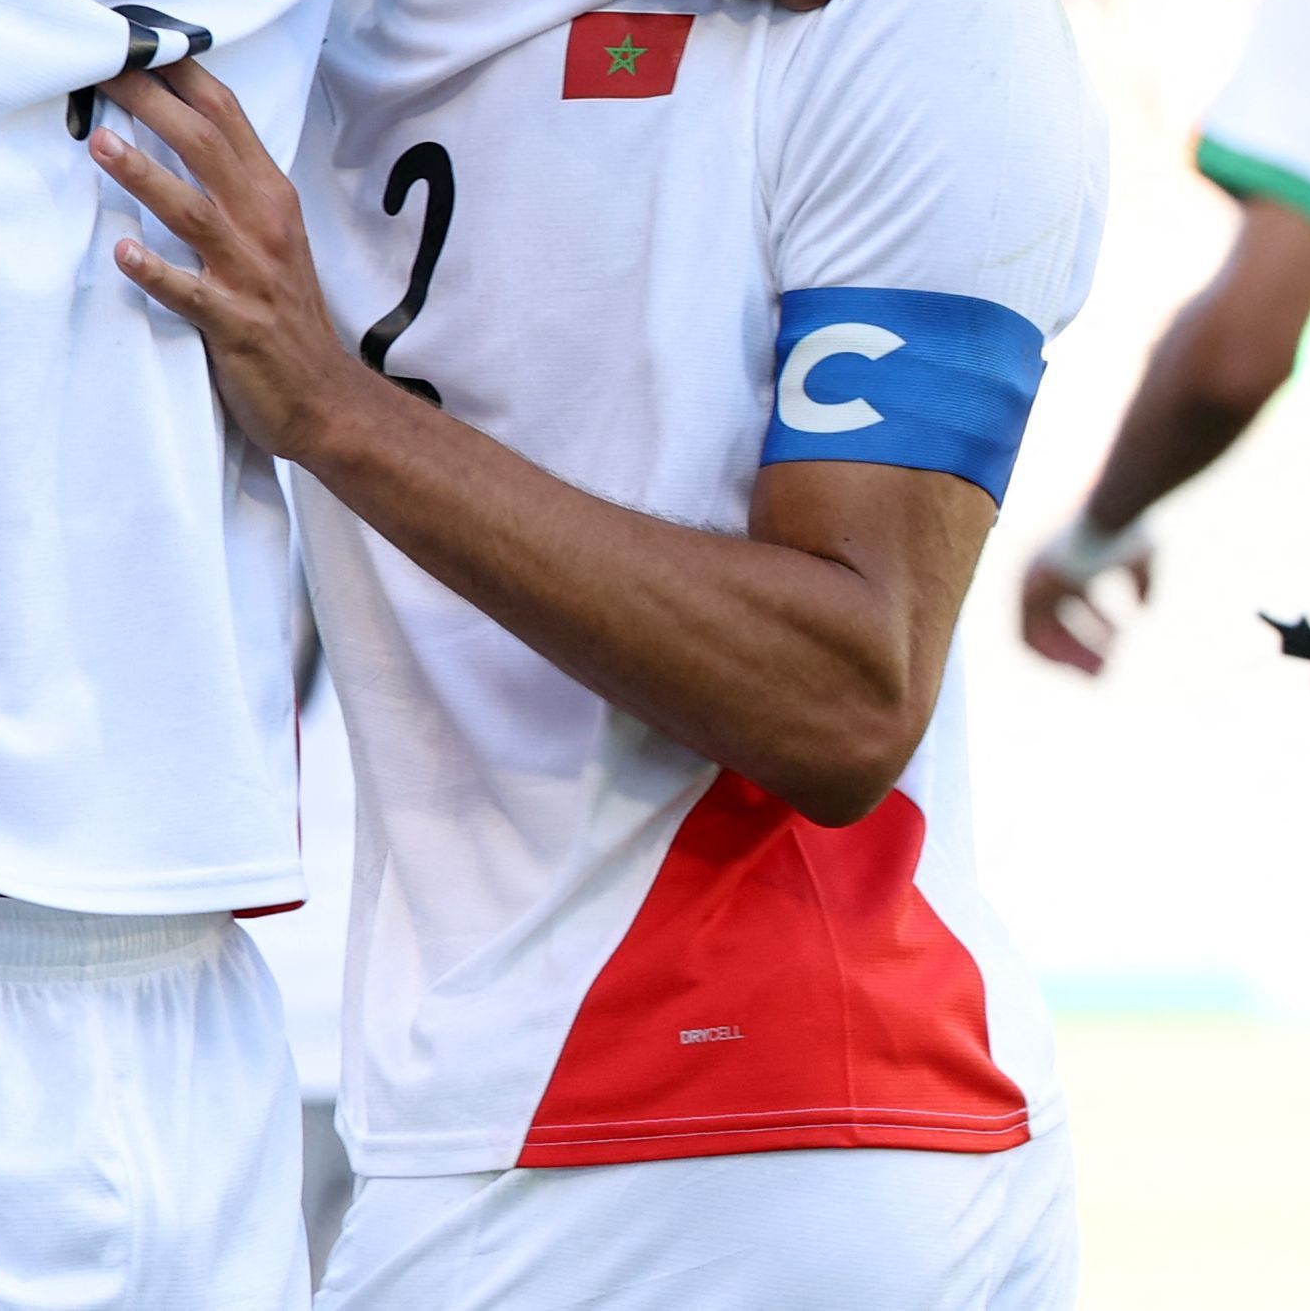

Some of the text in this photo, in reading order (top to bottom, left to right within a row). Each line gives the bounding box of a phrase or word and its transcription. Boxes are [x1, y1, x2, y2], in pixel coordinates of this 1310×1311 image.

[360, 141, 456, 409] 2
[777, 322, 908, 434] C
[679, 1024, 746, 1045] DRYCELL
